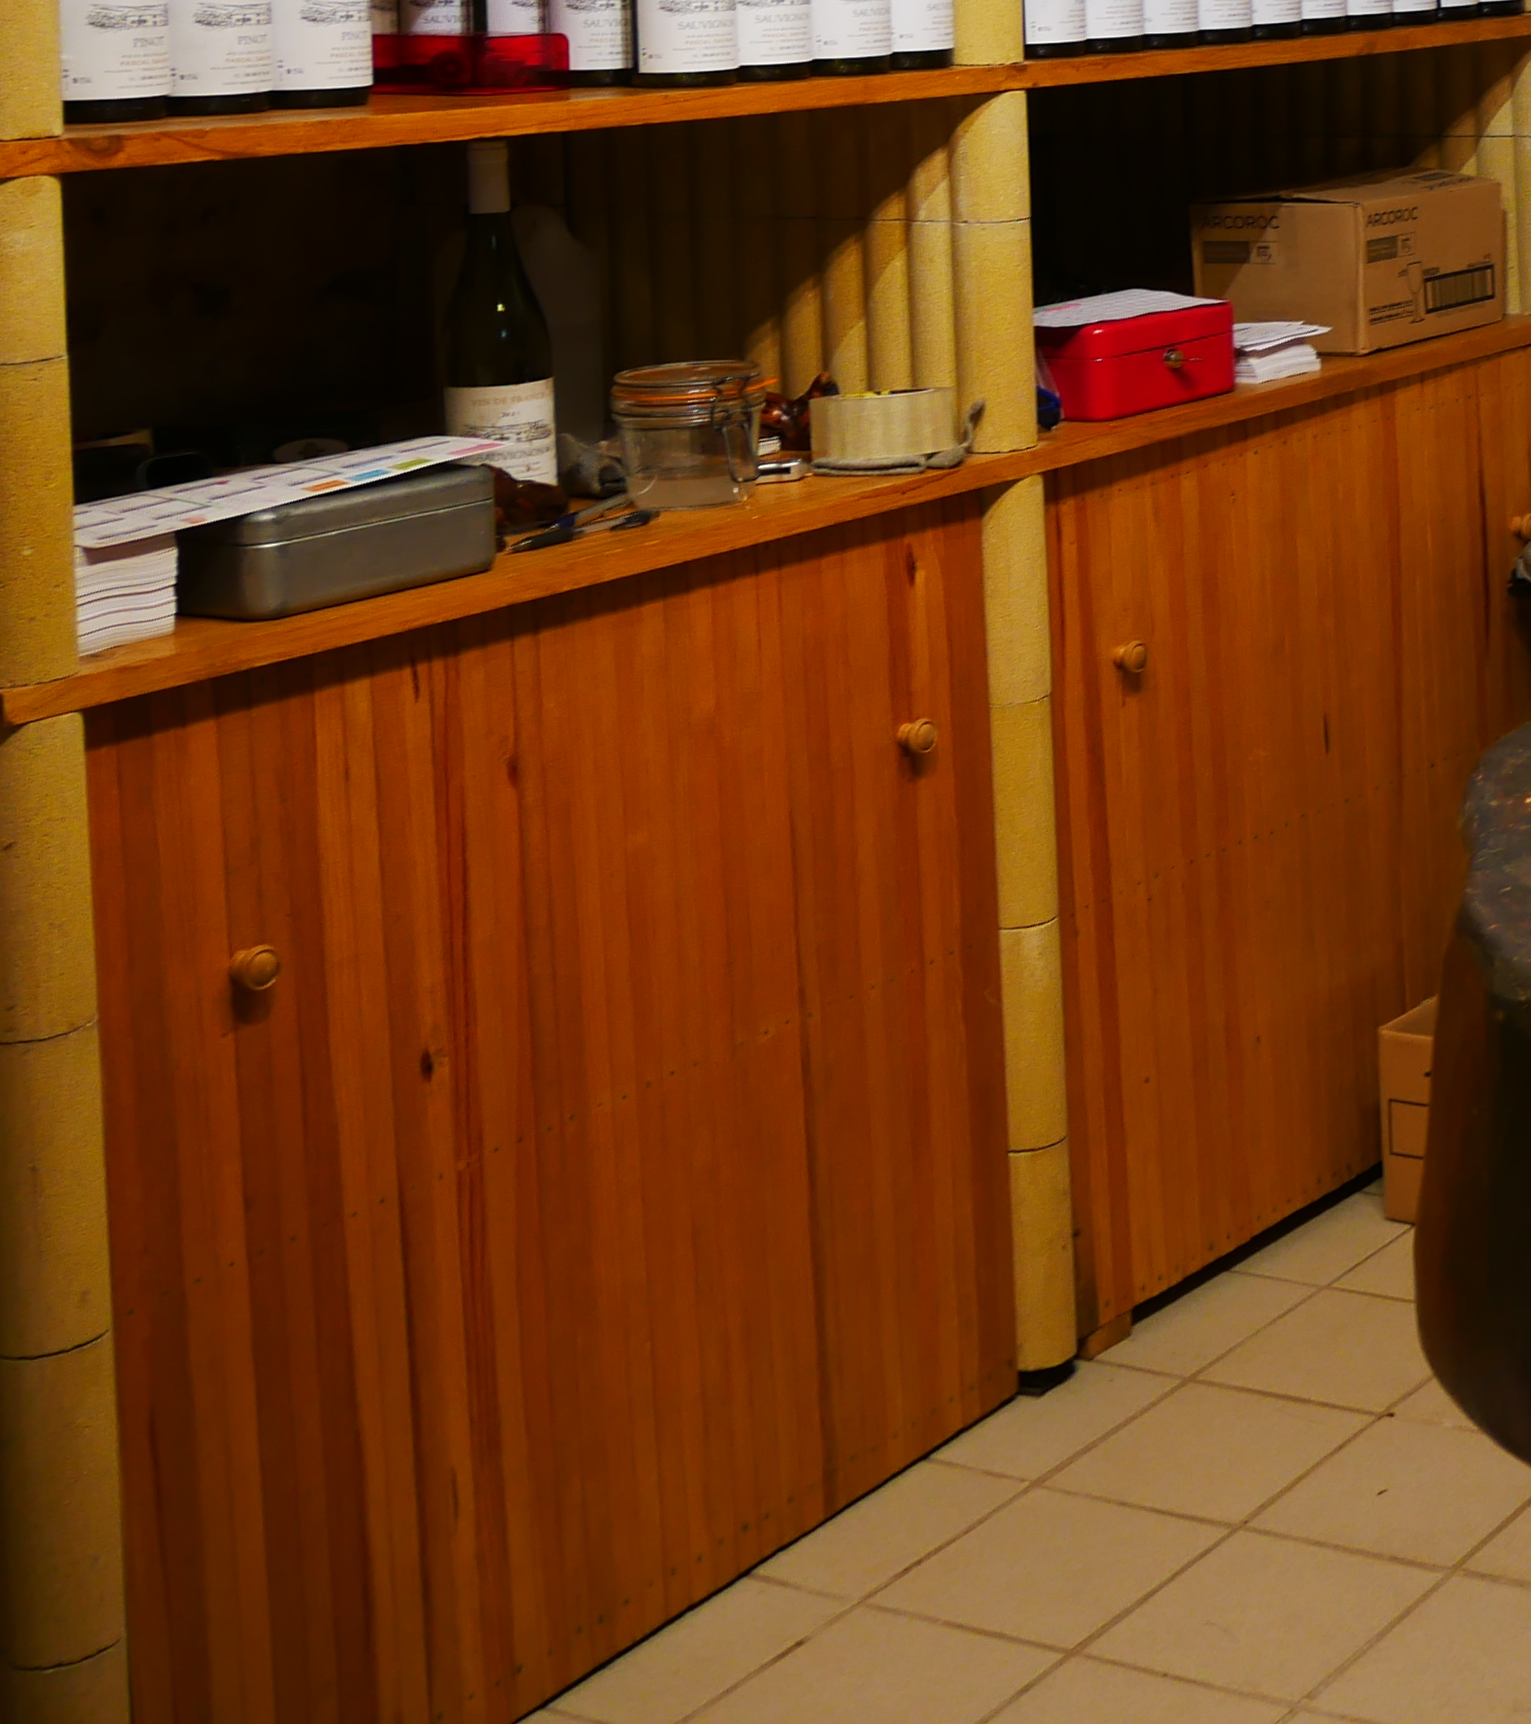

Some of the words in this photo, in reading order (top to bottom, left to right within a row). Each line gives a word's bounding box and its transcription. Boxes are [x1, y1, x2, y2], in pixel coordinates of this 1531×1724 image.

[132, 35, 165, 48] PINOT
[237, 33, 268, 46] PINOT
[1201, 215, 1280, 231] ARCOROC
[1366, 205, 1419, 228] ARCOROC
